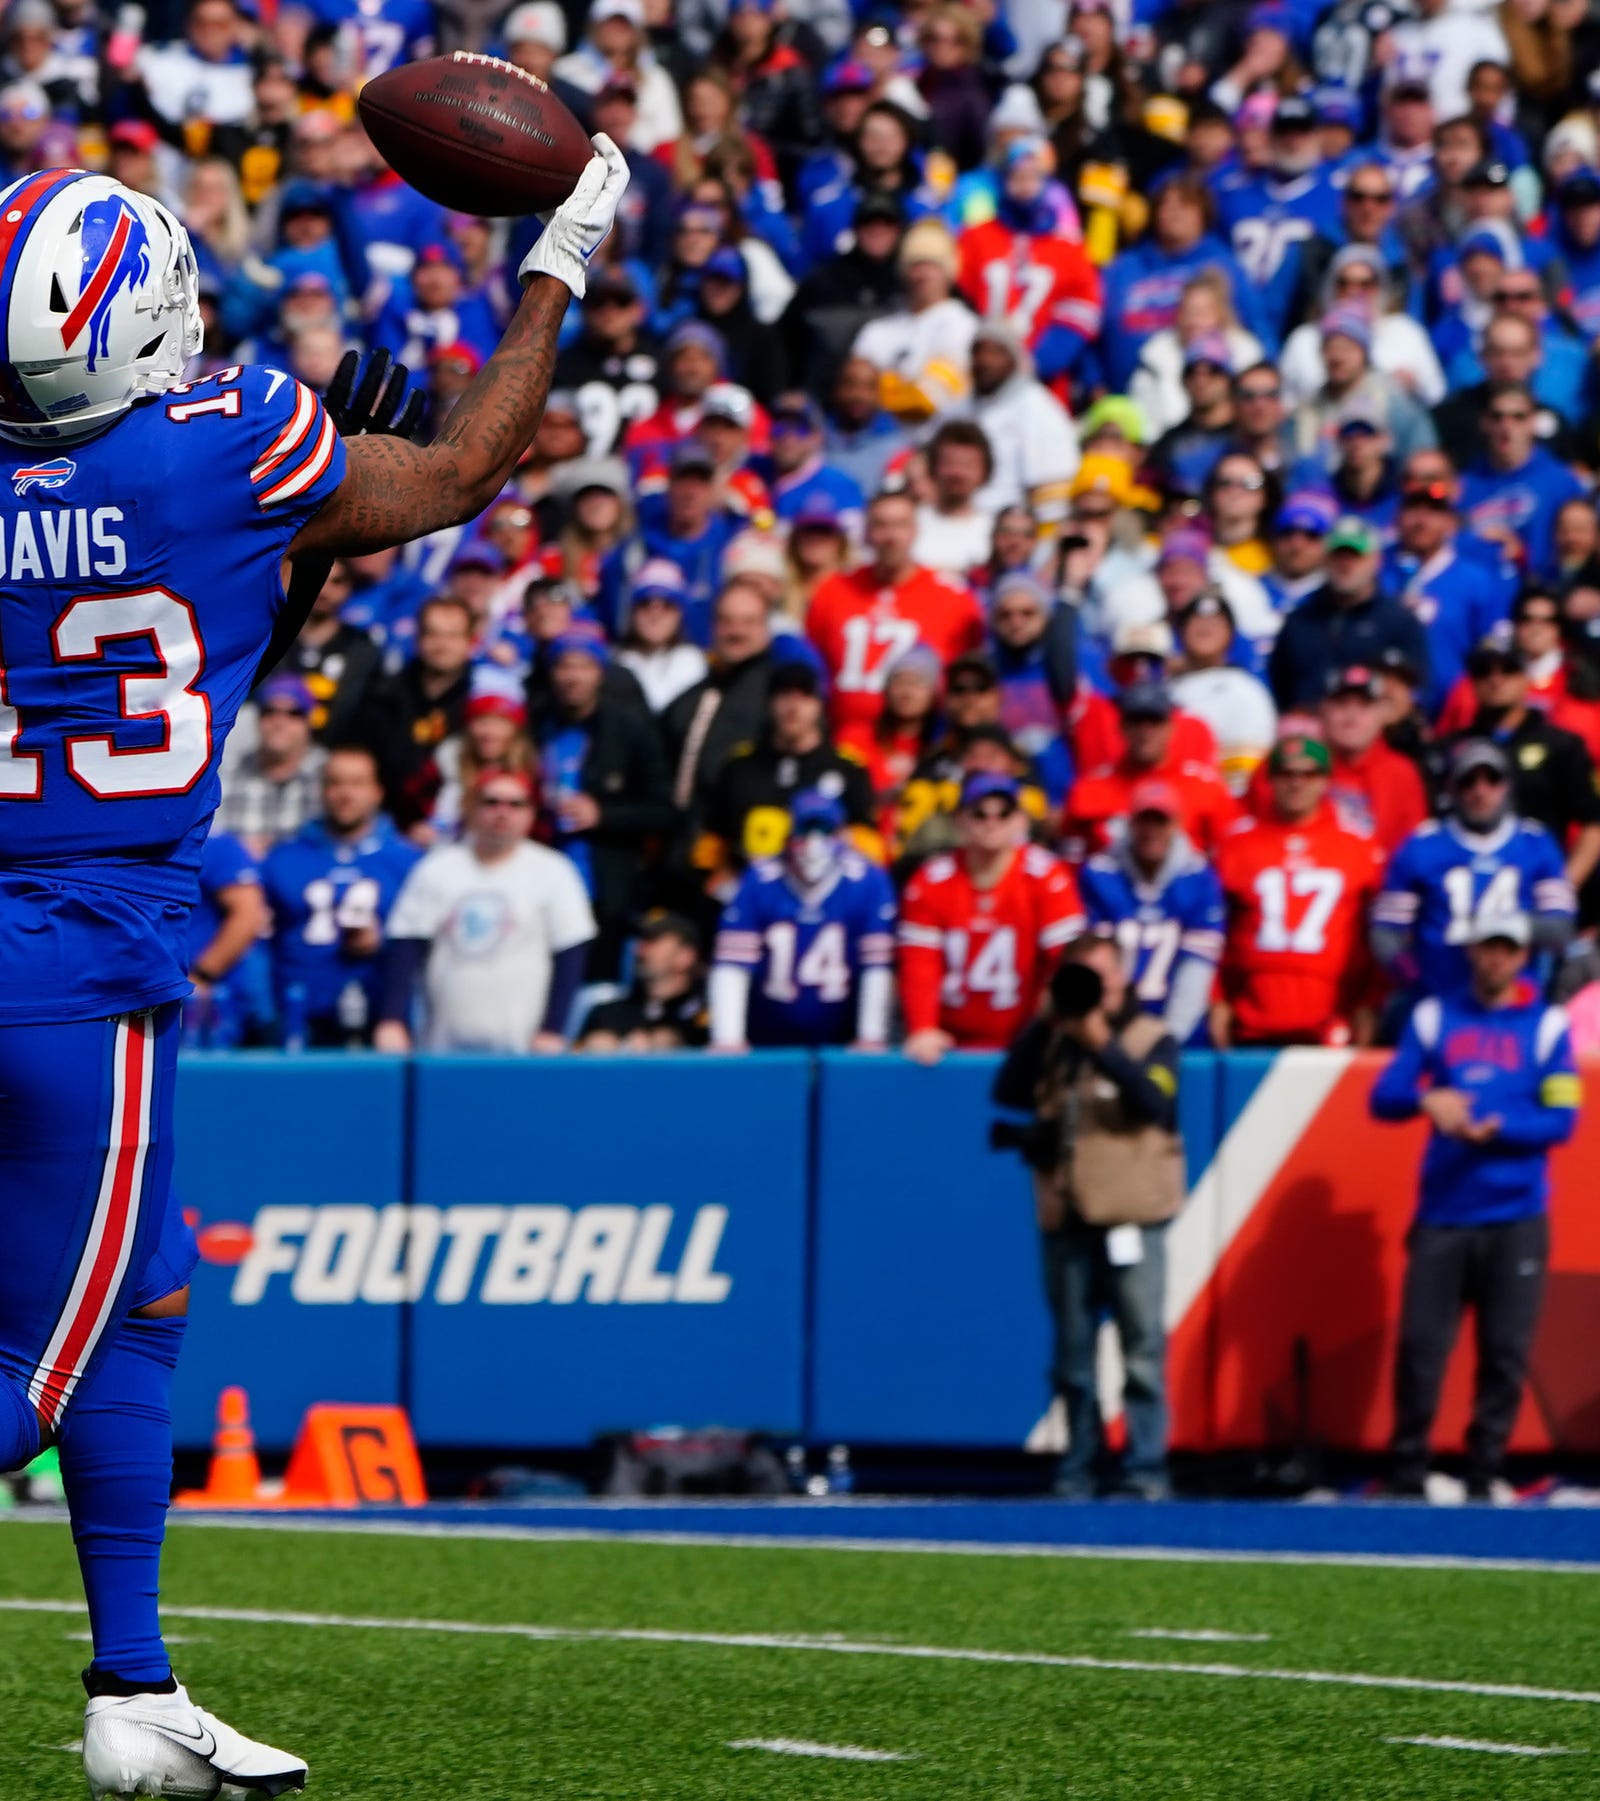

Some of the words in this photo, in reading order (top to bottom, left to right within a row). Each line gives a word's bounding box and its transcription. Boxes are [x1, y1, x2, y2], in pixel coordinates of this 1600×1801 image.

[467, 100, 518, 129] FOOTBALL
[837, 613, 918, 694] 17
[302, 878, 380, 946] 14
[1254, 867, 1345, 954] 17
[1443, 866, 1522, 946] 14
[763, 921, 849, 1002] 14
[941, 925, 1021, 1009] 14
[1116, 918, 1180, 1000] 17
[232, 1204, 733, 1304] FOOTBALL
[340, 1426, 402, 1505] G
